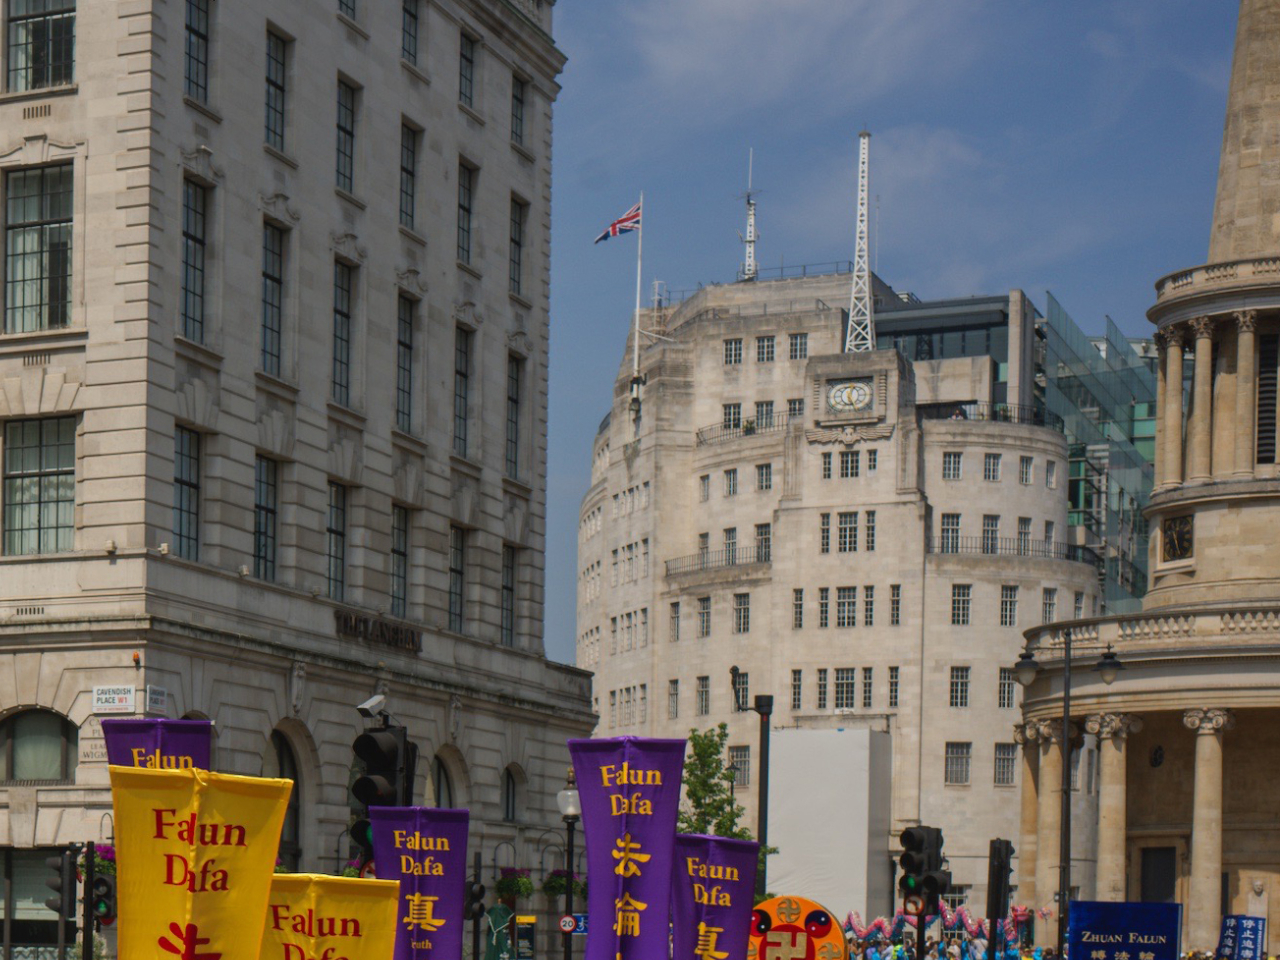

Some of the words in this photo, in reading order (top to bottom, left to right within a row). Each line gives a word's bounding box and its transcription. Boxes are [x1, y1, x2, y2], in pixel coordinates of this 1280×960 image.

[96, 687, 132, 696] CAVENDISH
[96, 696, 116, 705] PLACE
[117, 696, 128, 704] W1
[131, 747, 193, 770] Falun
[599, 761, 663, 788] Falun
[609, 792, 654, 816] Dafa
[151, 808, 248, 847] Falun
[393, 829, 451, 851] Falun
[400, 855, 444, 876] Dafa
[686, 857, 740, 881] Faun
[269, 904, 363, 938] Falun
[402, 892, 447, 932] 真
[562, 920, 574, 929] 20
[411, 938, 432, 950] ruth
